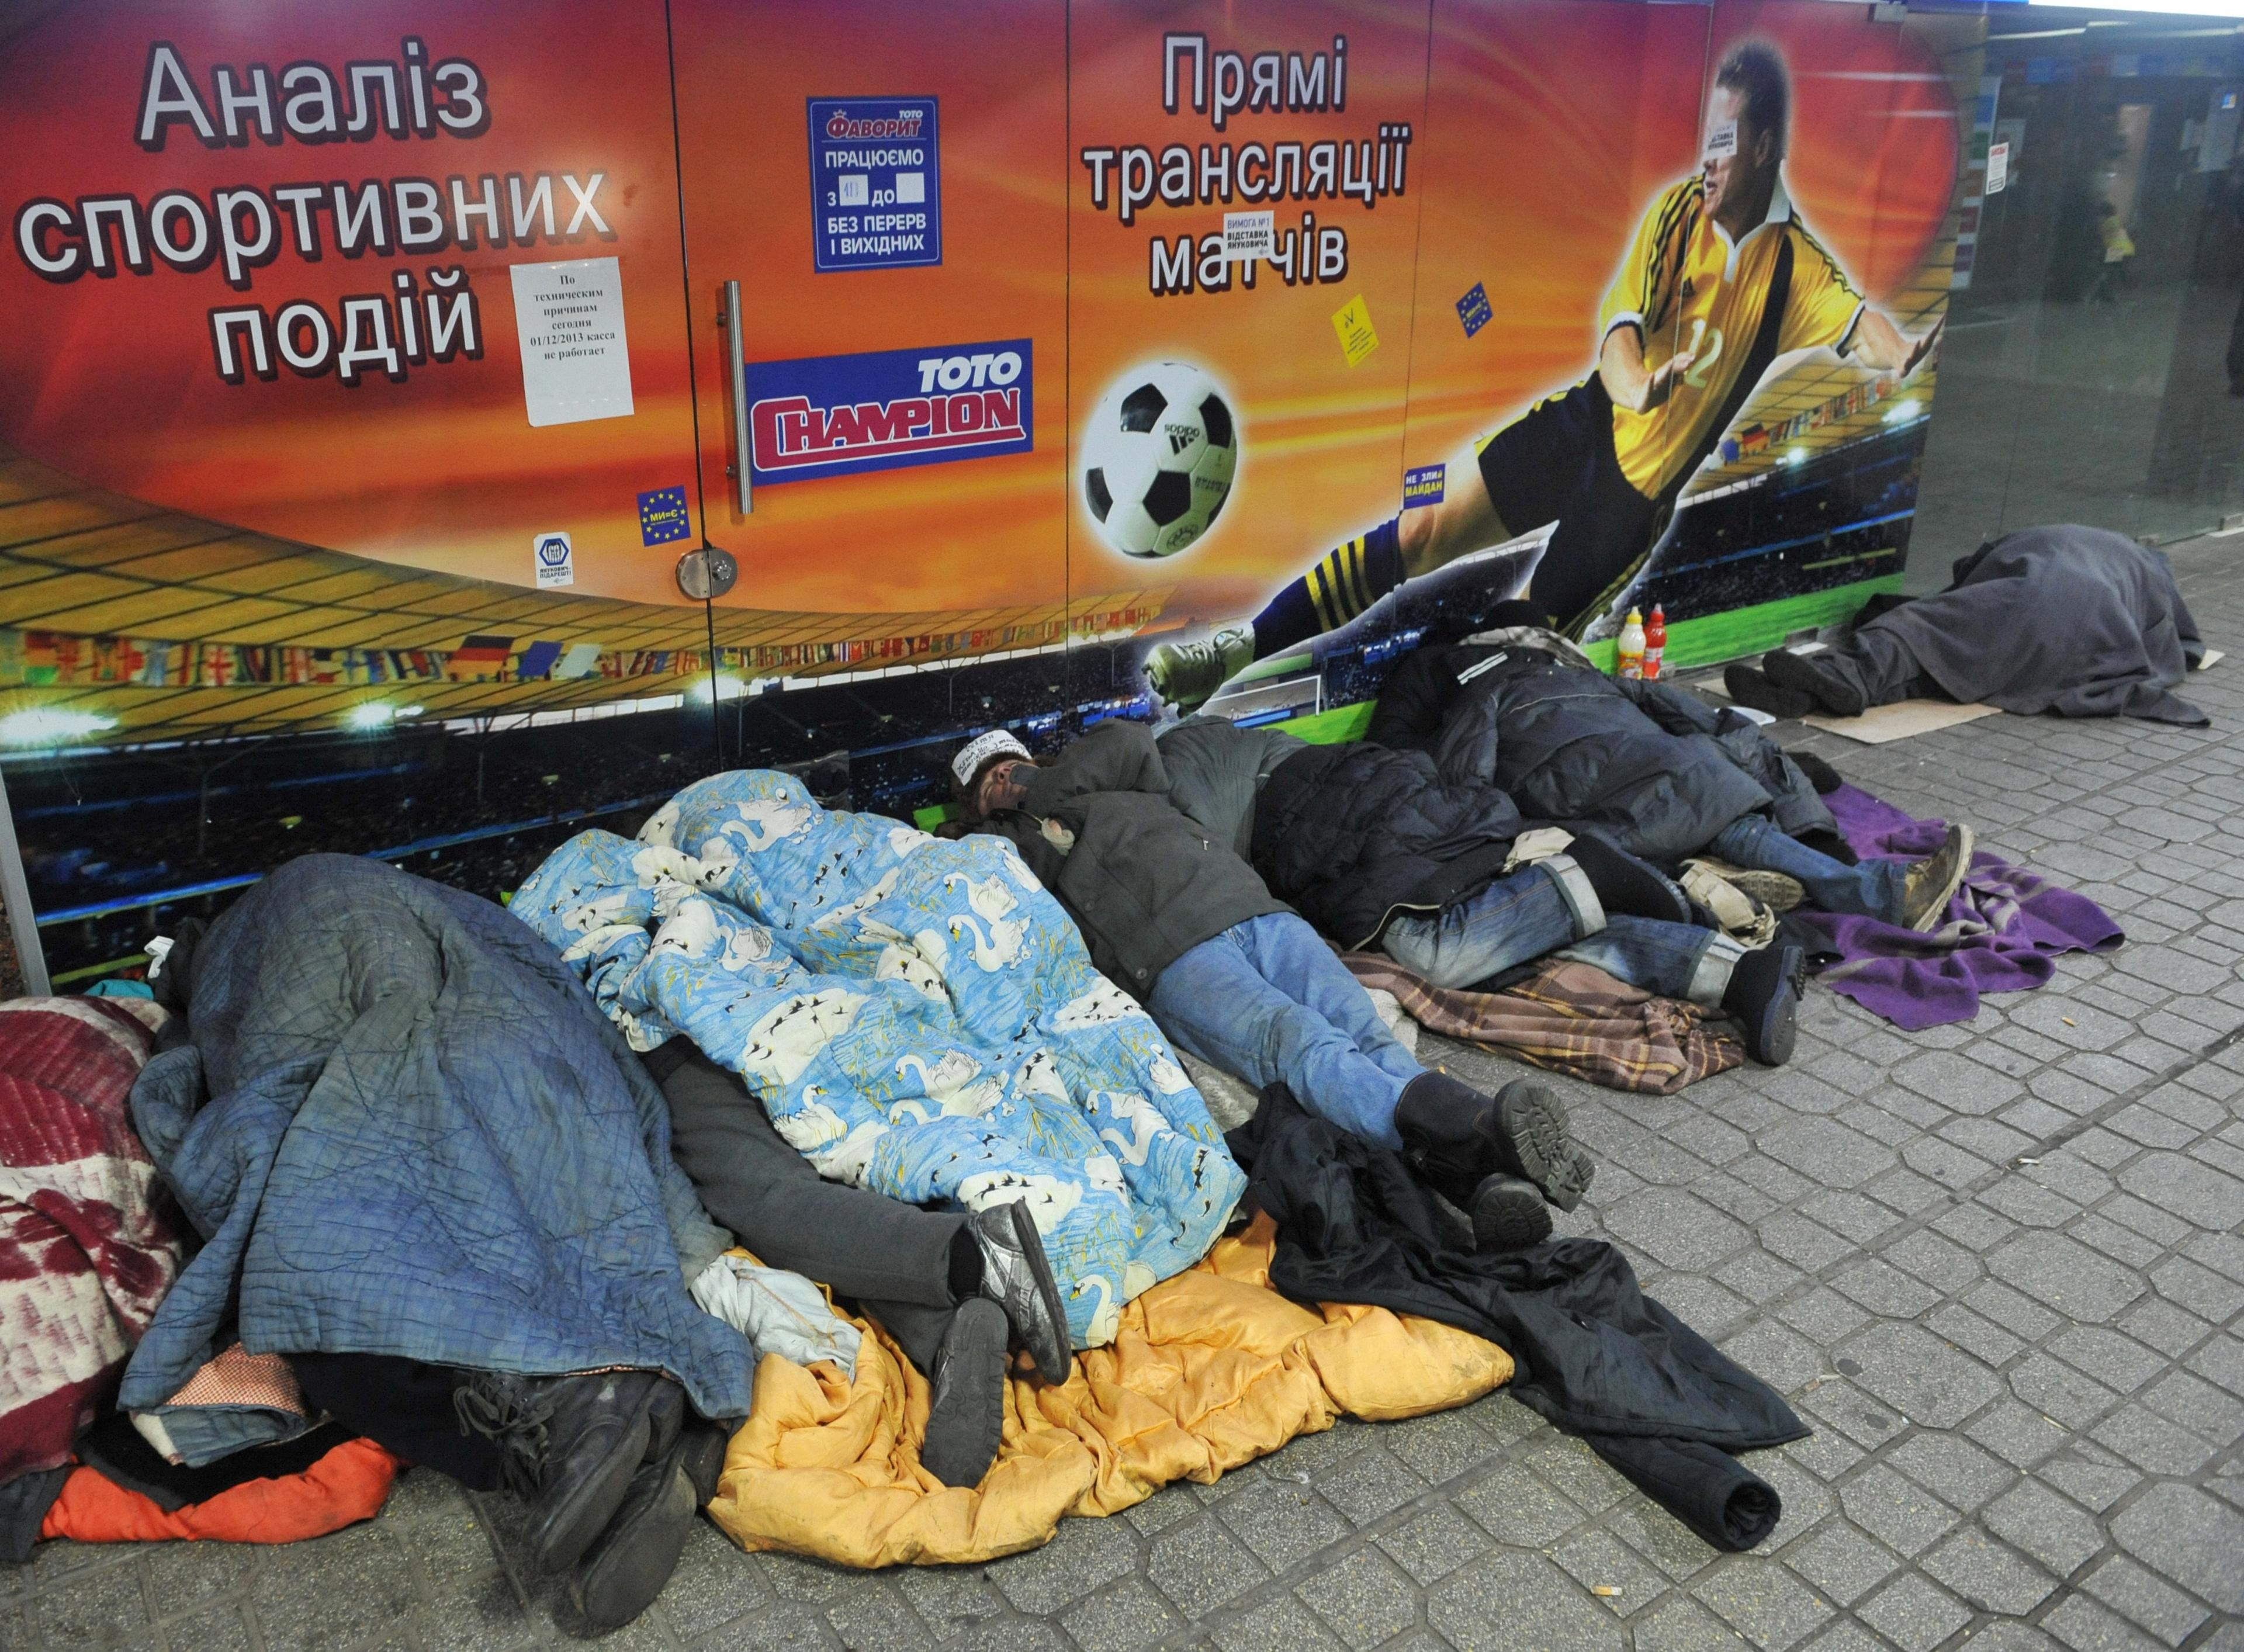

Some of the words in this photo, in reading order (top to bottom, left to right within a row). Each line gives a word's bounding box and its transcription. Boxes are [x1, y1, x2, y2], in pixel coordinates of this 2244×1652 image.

[1164, 35, 1348, 125] Прямі
[138, 40, 486, 145] Аналіз
[826, 116, 922, 138] ФАВОРИТ
[825, 148, 924, 169] ПРАЦЮЄМО
[1083, 126, 1410, 220] трансляції
[871, 189, 895, 207] ДО
[18, 172, 611, 282] спортивних
[827, 216, 858, 234] БЕЗ
[864, 213, 926, 232] ПЕРЕРВ
[1227, 218, 1256, 229] ВИМОГА
[830, 238, 836, 255] І
[840, 234, 924, 255] ВИХІДНИХ
[1227, 230, 1268, 241] ВІДСТАВКА
[1227, 239, 1268, 250] ЯНУКОВИЧА
[560, 275, 576, 285] По
[533, 289, 604, 302] техническим
[543, 304, 598, 318] причинам
[213, 270, 477, 380] подій
[552, 320, 592, 330] сегодня
[530, 333, 584, 347] 01/12/2013
[587, 332, 615, 341] касса
[544, 351, 556, 360] не
[559, 347, 605, 361] работает
[917, 351, 1023, 393] TOTO
[751, 387, 1027, 472] CHAMPION
[1405, 475, 1417, 484] НЕ
[1421, 470, 1443, 482] ЗЛИЙ
[1405, 480, 1443, 497] МАЙДАН
